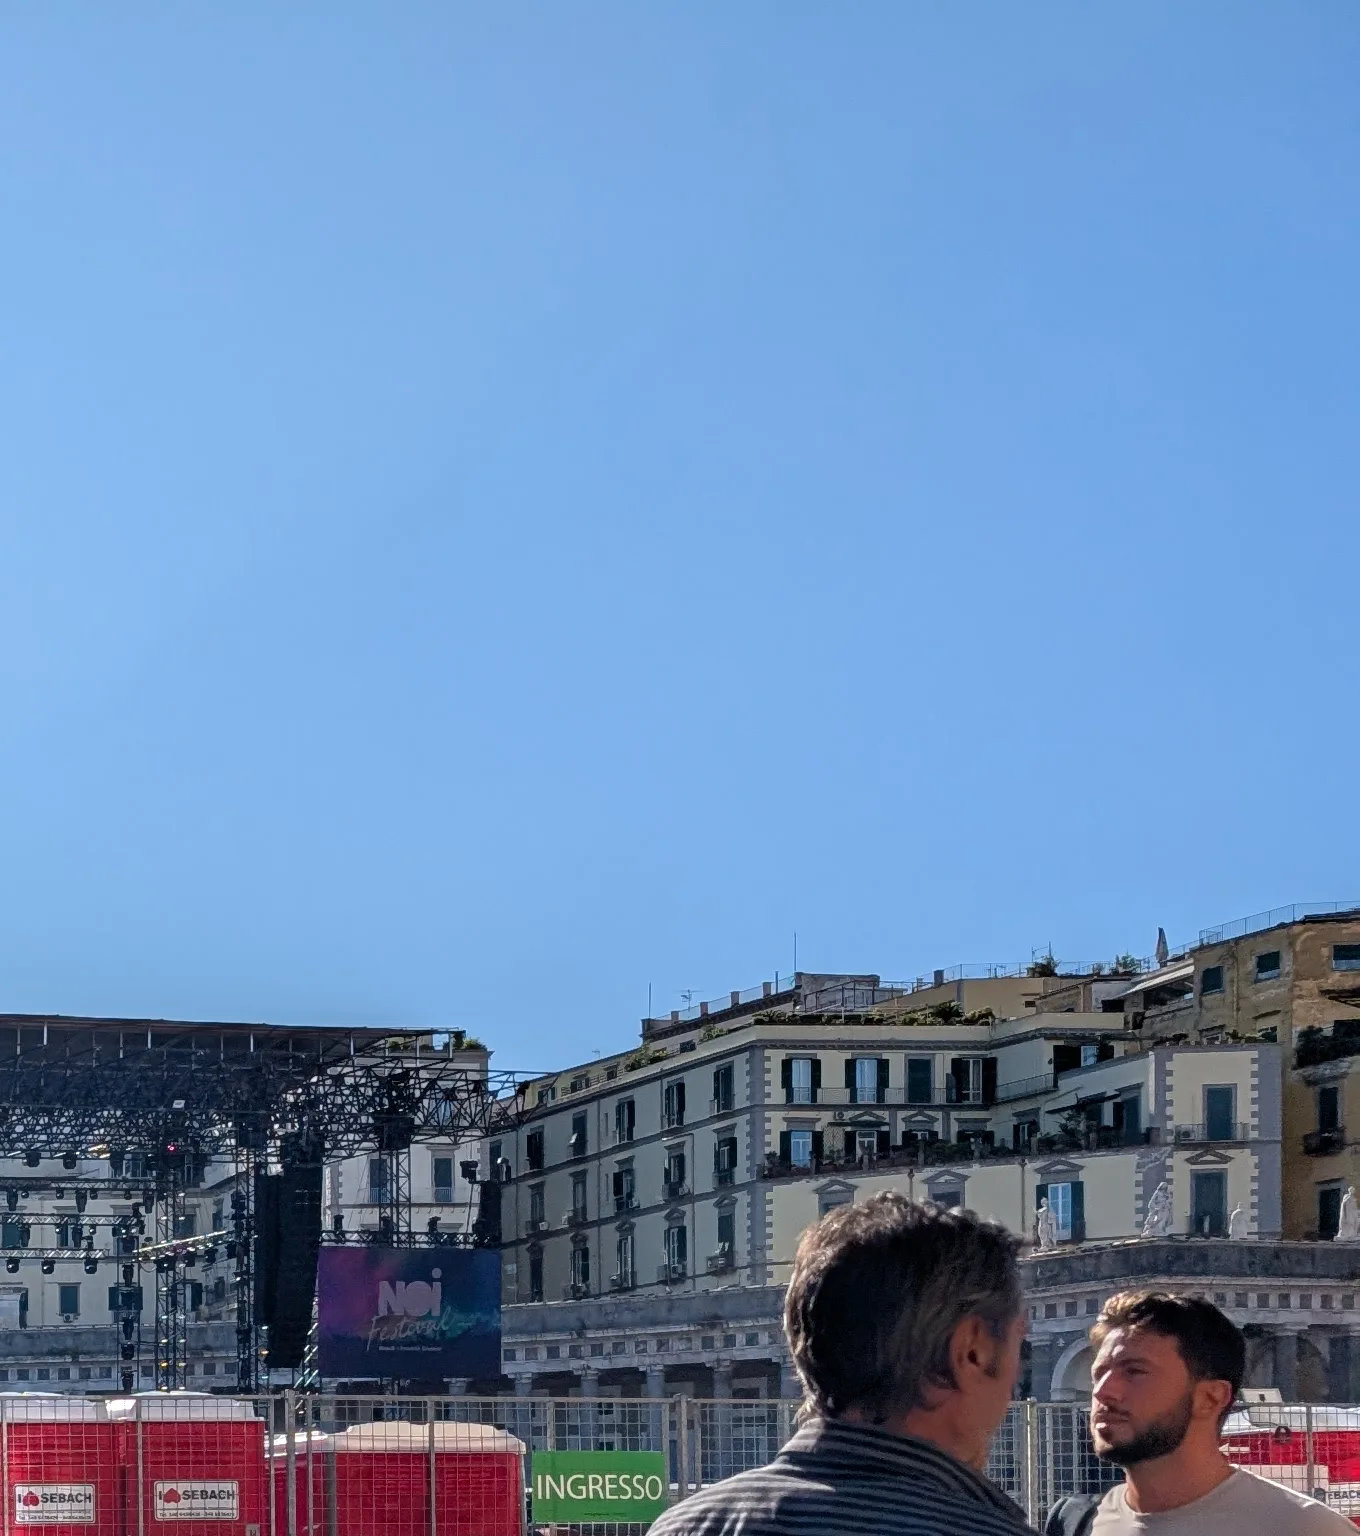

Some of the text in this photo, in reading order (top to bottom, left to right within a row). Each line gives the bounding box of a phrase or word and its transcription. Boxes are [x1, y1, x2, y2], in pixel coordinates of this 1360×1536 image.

[366, 1305, 454, 1352] Festival
[182, 1489, 235, 1500] SEBACH
[537, 1474, 663, 1500] INGRESSO
[40, 1493, 92, 1503] SEBACH
